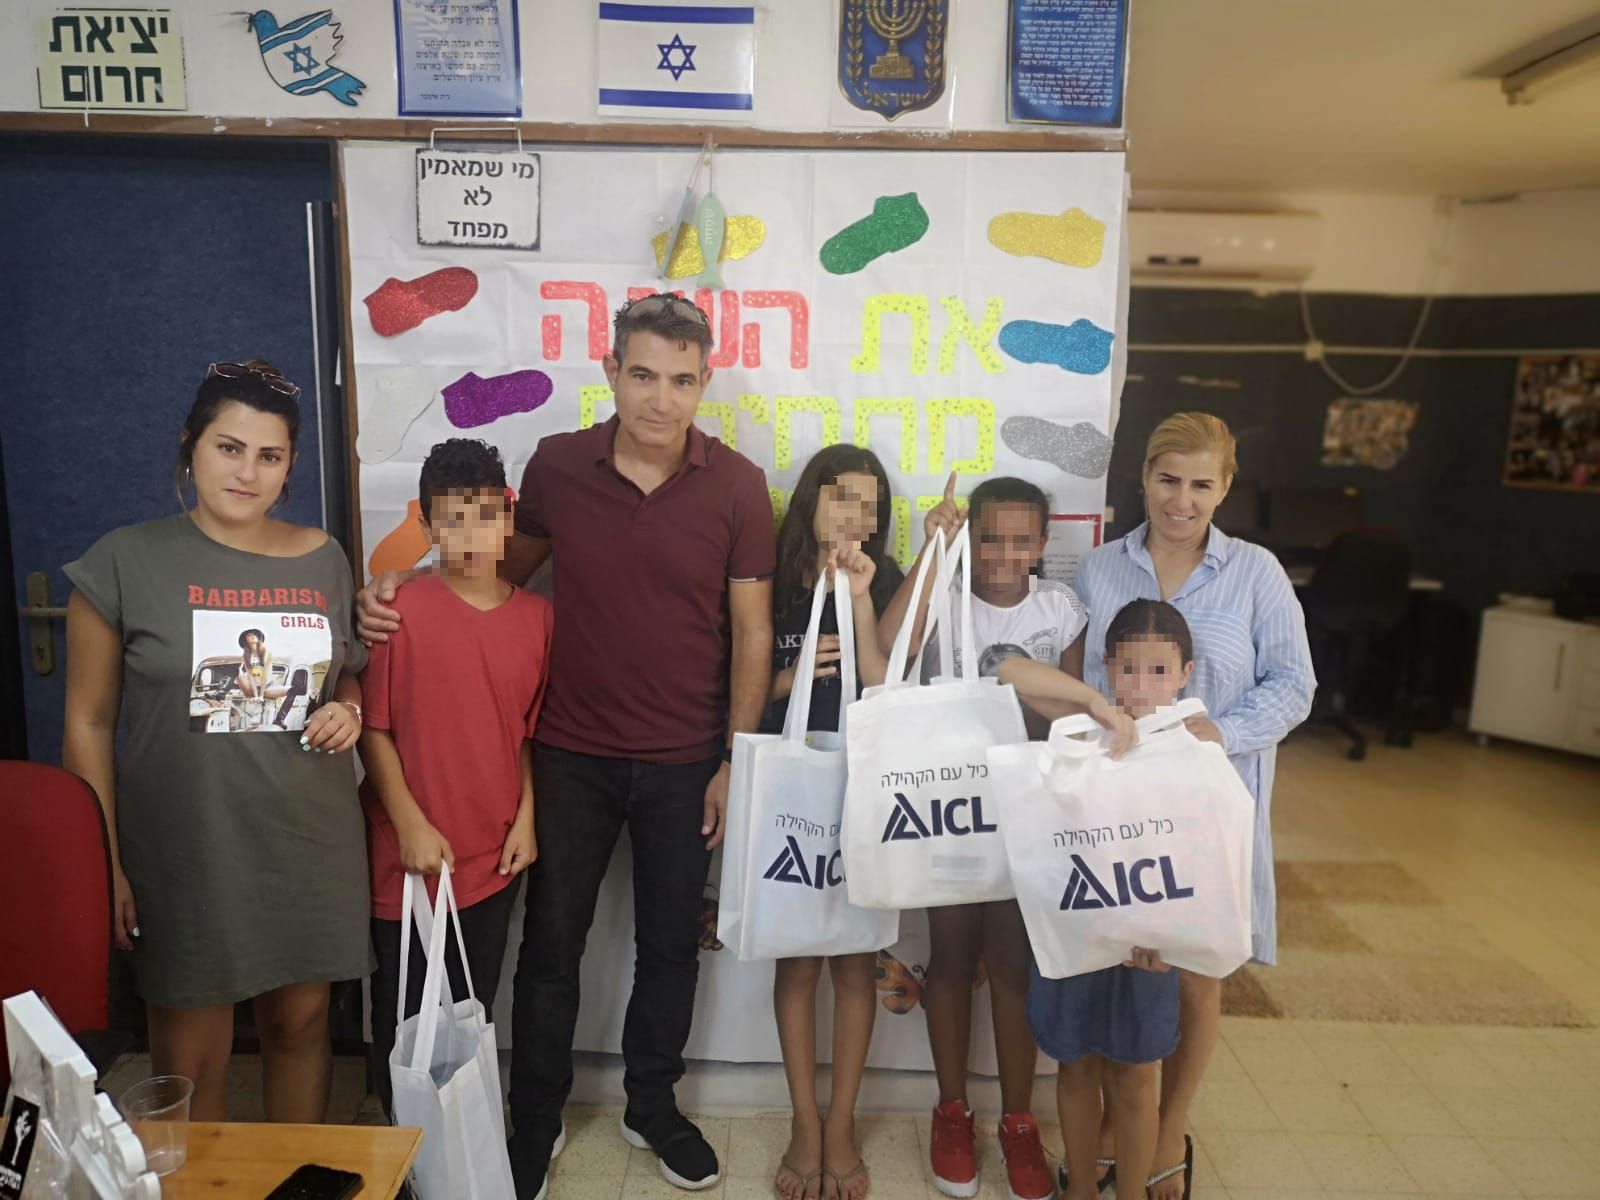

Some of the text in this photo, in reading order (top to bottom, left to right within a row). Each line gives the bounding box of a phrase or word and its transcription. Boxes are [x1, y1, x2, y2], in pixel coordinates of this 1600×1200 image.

[49, 16, 169, 54] יציאת
[61, 65, 164, 103] חרום
[863, 81, 921, 107] ישראל
[420, 158, 535, 180] מי שמאמין
[463, 185, 493, 206] לא
[447, 221, 508, 239] מפחד
[849, 291, 1006, 376] את
[280, 615, 326, 630] GIRLS
[881, 763, 989, 789] כיל עם הקהילה
[775, 813, 825, 838] הקהילה
[1053, 818, 1174, 848] כיל עם הקהילה
